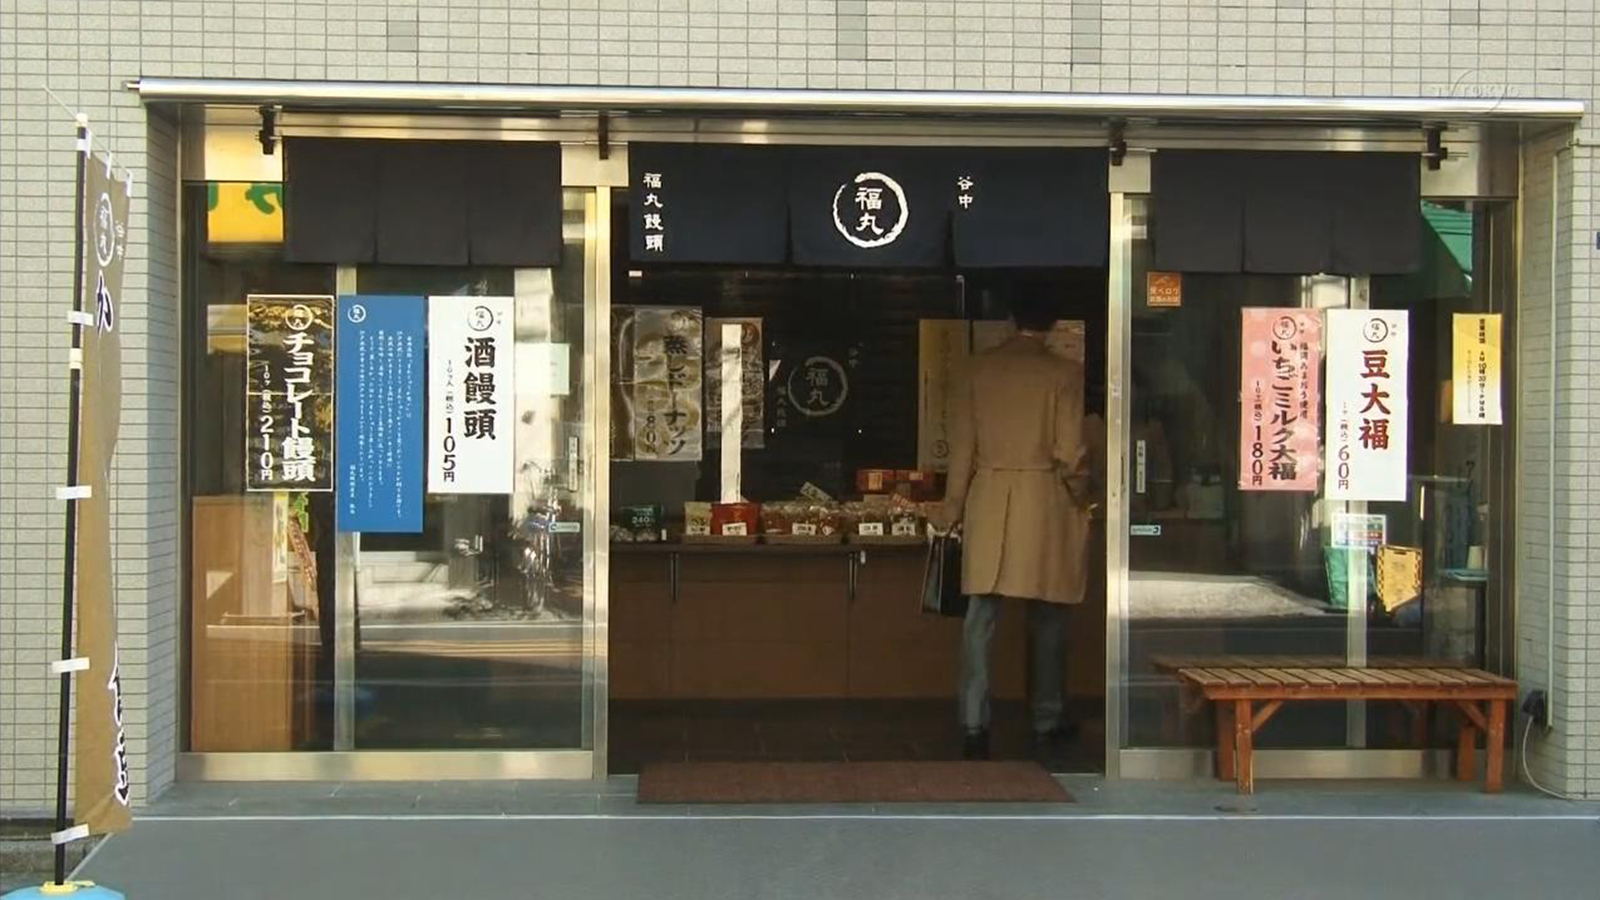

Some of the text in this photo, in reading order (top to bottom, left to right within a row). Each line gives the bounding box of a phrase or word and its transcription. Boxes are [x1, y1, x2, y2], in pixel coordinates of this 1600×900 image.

[643, 173, 664, 252] 福丸饅頭
[855, 187, 884, 235] 福丸
[957, 176, 974, 209] 谷中
[282, 332, 317, 482] チョコレート饅頭
[464, 336, 497, 441] 酒饅頭
[1269, 340, 1299, 481] いちごミルク大福
[1359, 349, 1391, 451] 豆大福
